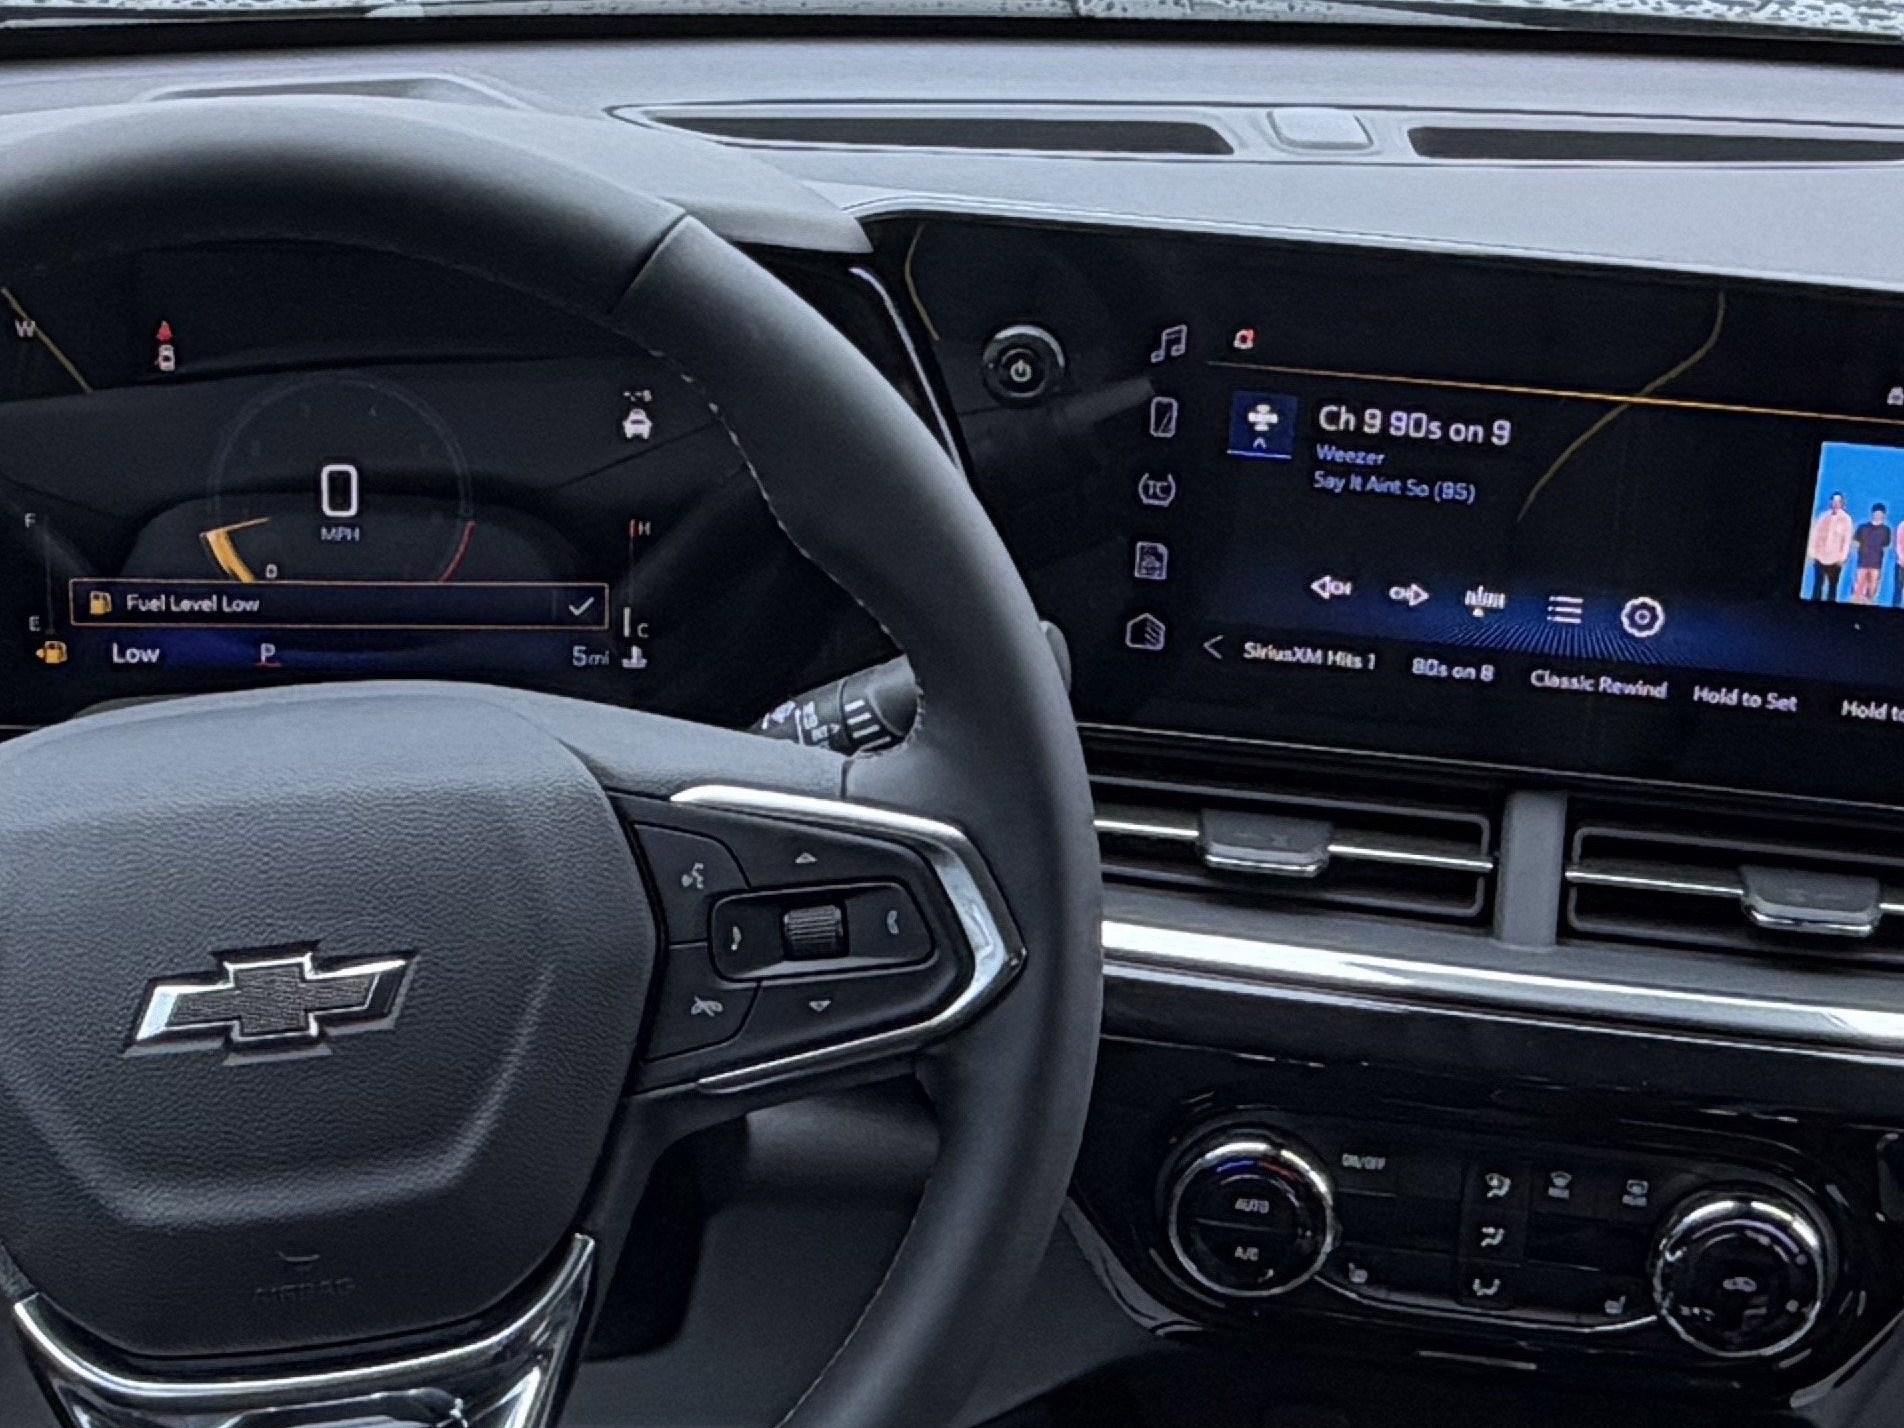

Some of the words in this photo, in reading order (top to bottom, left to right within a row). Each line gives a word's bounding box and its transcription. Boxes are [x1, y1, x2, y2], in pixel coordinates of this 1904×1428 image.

[14, 319, 36, 339] W
[1318, 405, 1356, 432] Ch
[1362, 408, 1382, 434] 9
[1389, 410, 1442, 440] 90s
[1448, 422, 1484, 444] on
[1490, 419, 1512, 446] 9
[1316, 443, 1385, 466] Weezer
[320, 463, 359, 518] 0
[1313, 470, 1346, 494] Say
[1349, 473, 1363, 491] It
[1405, 478, 1430, 497] So
[24, 512, 36, 528] F
[319, 526, 361, 542] MPH
[126, 594, 166, 612] Fuel
[169, 594, 218, 613] Level
[222, 594, 260, 613] Low
[28, 616, 41, 632] E
[112, 642, 160, 664] Low
[260, 643, 276, 662] P
[1243, 640, 1325, 667] SiriusXM
[1327, 647, 1363, 670] Hits
[1451, 664, 1476, 681] on
[1530, 669, 1596, 694] Classic
[1598, 676, 1668, 700] Rewind
[1693, 684, 1739, 707] Hold
[1741, 691, 1762, 709] to
[1766, 692, 1798, 713] Set
[1841, 699, 1888, 721] Hold
[1234, 1198, 1270, 1214] AUTO
[1234, 1246, 1260, 1261] A/C
